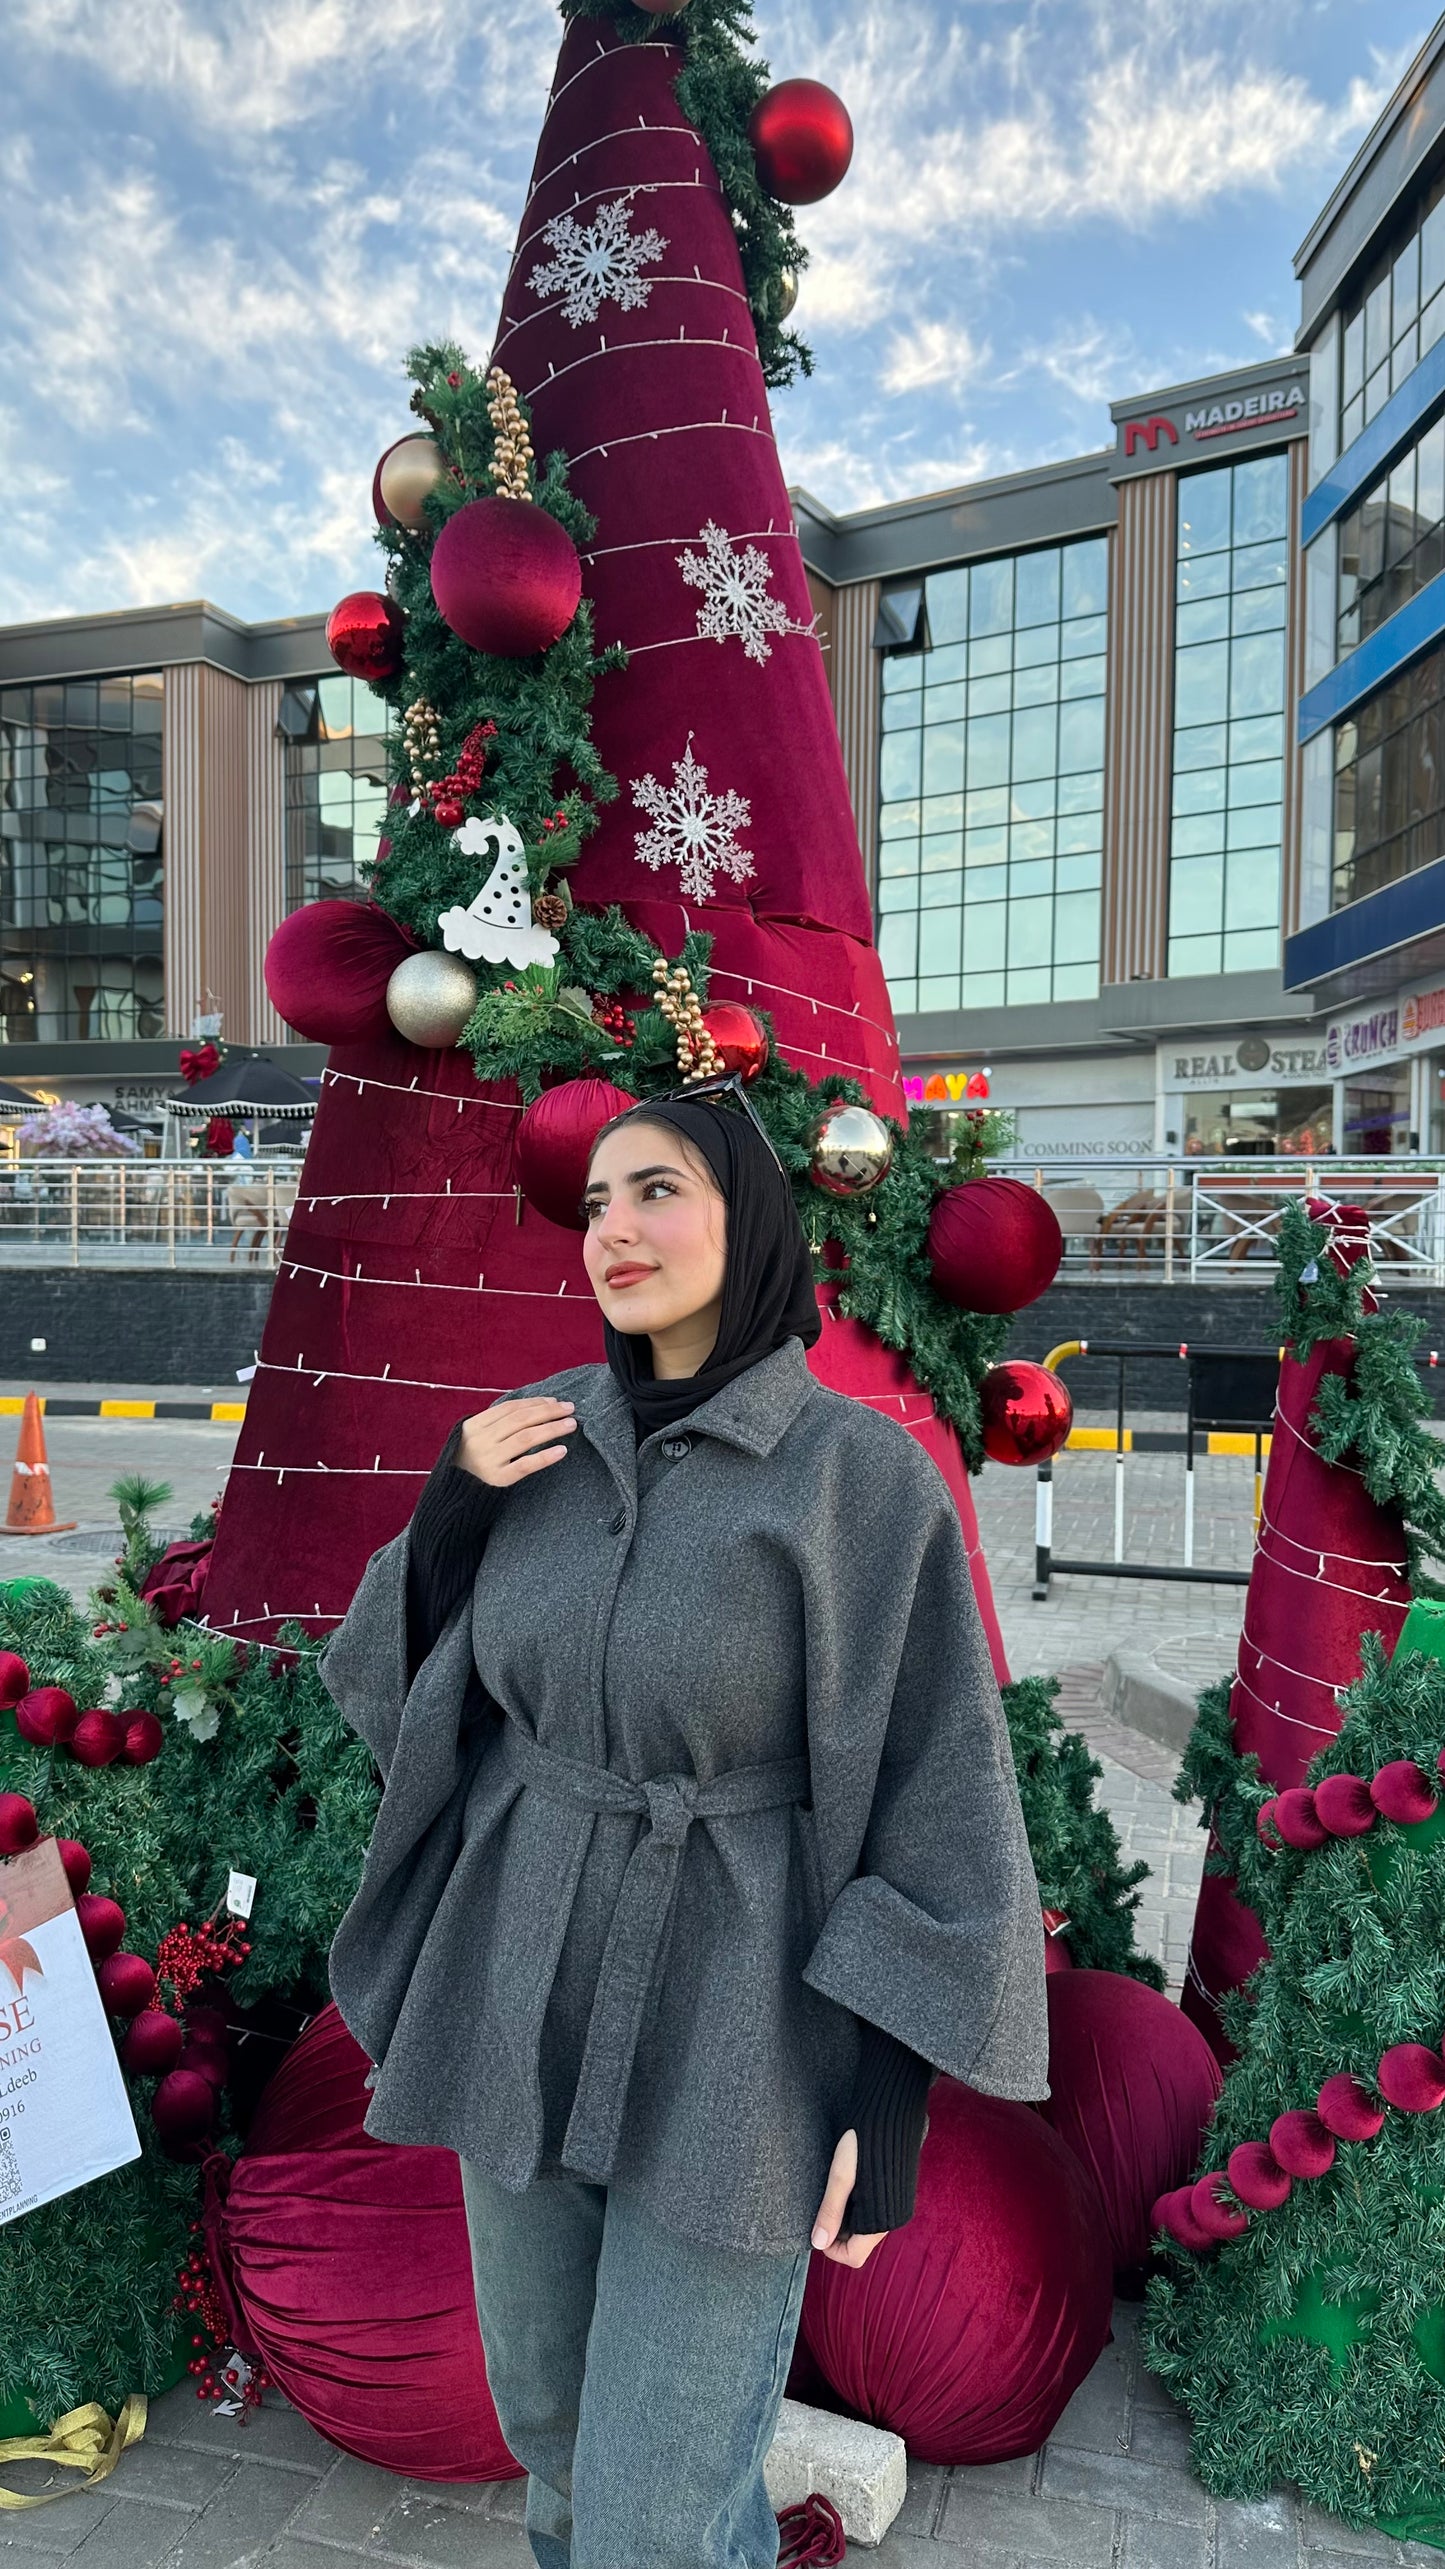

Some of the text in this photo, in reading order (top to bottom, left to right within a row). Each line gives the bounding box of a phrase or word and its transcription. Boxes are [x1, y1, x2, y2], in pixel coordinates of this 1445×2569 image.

[1184, 386, 1306, 432] MADEIRA
[1175, 1056, 1236, 1078] REAL
[1023, 1140, 1152, 1156] COMMING SOON
